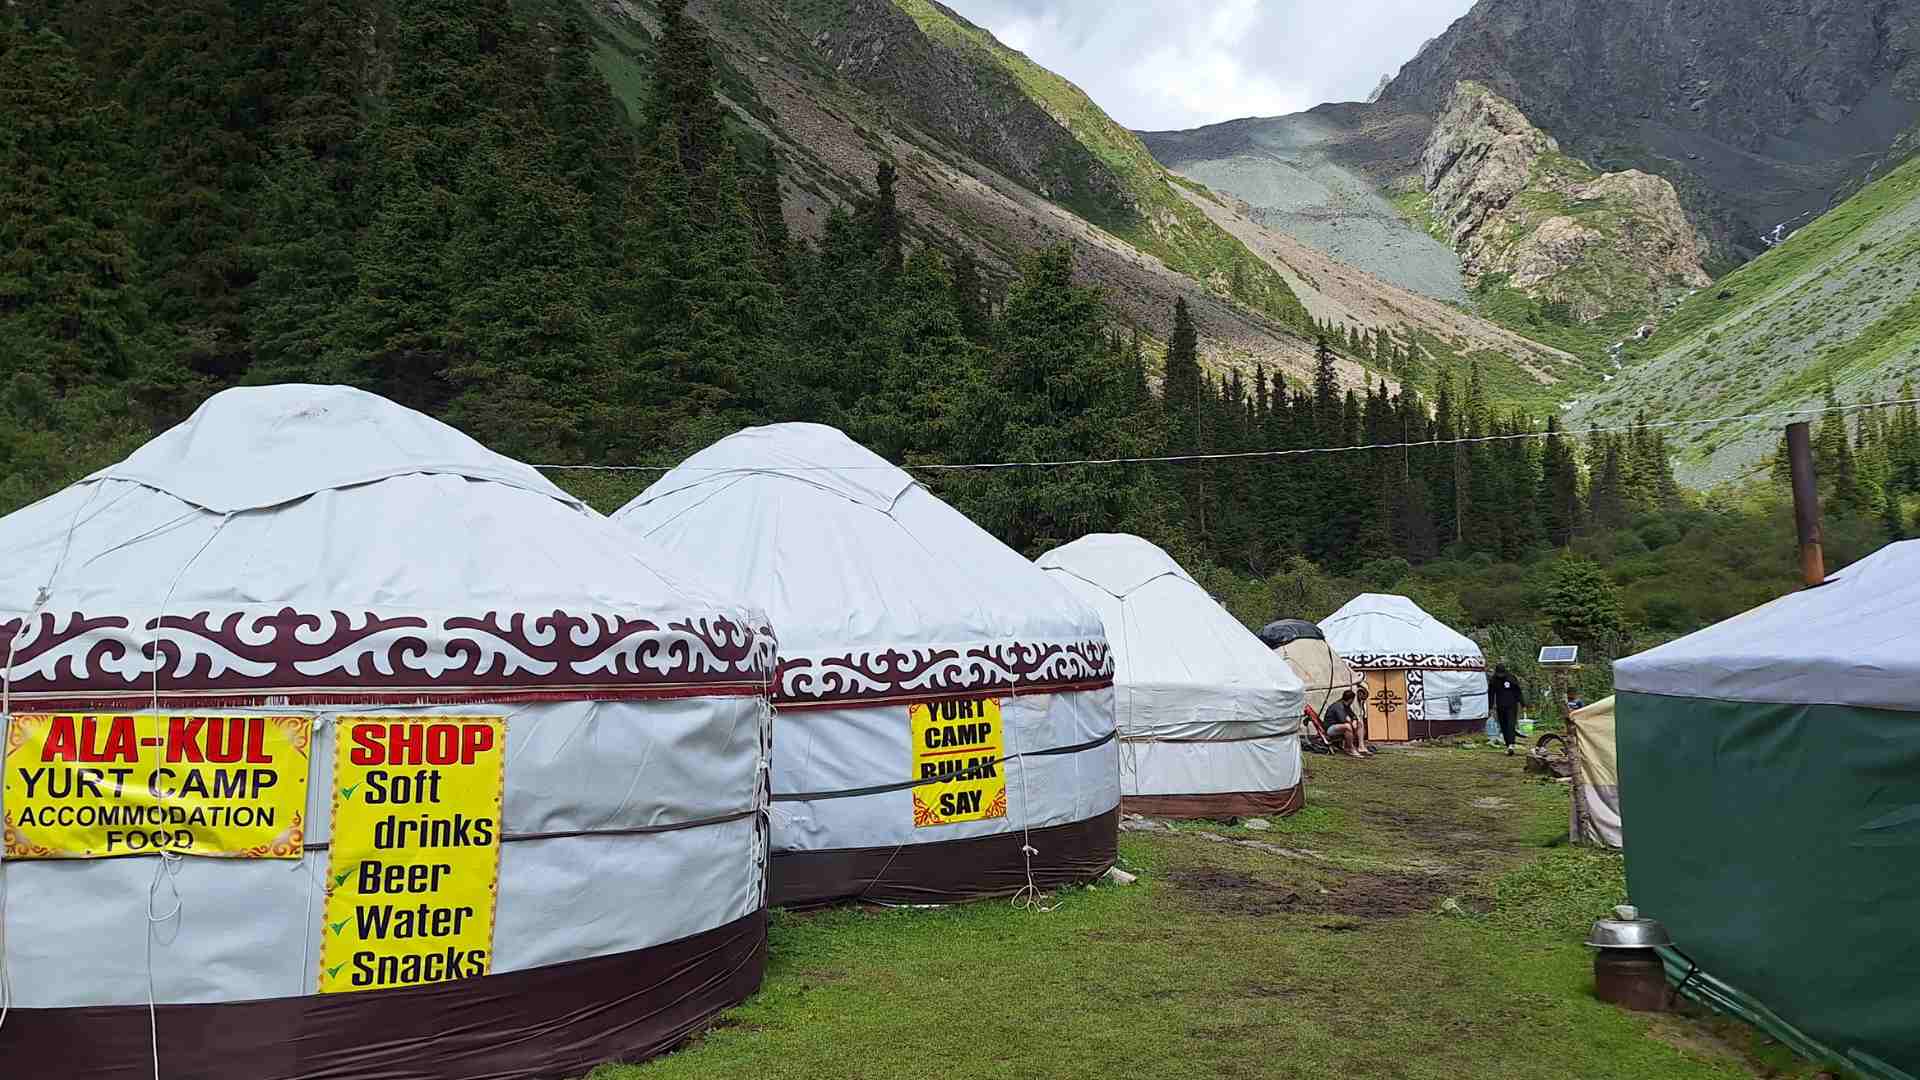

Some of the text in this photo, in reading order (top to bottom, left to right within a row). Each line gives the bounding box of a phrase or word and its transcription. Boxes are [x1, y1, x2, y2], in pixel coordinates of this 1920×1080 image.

[927, 698, 985, 721] YURT
[41, 716, 272, 764] ALA-KUL
[350, 724, 494, 767] SHOP
[925, 722, 991, 748] CAMP
[19, 768, 278, 800] YURT CAMP
[365, 770, 441, 805] Soft
[18, 806, 275, 828] ACCOMMODATION
[940, 790, 982, 816] SAY
[106, 829, 194, 852] FOOD
[374, 814, 493, 850] drinks
[358, 860, 451, 894] Beer
[355, 904, 473, 940] Water
[351, 946, 486, 987] Snacks
